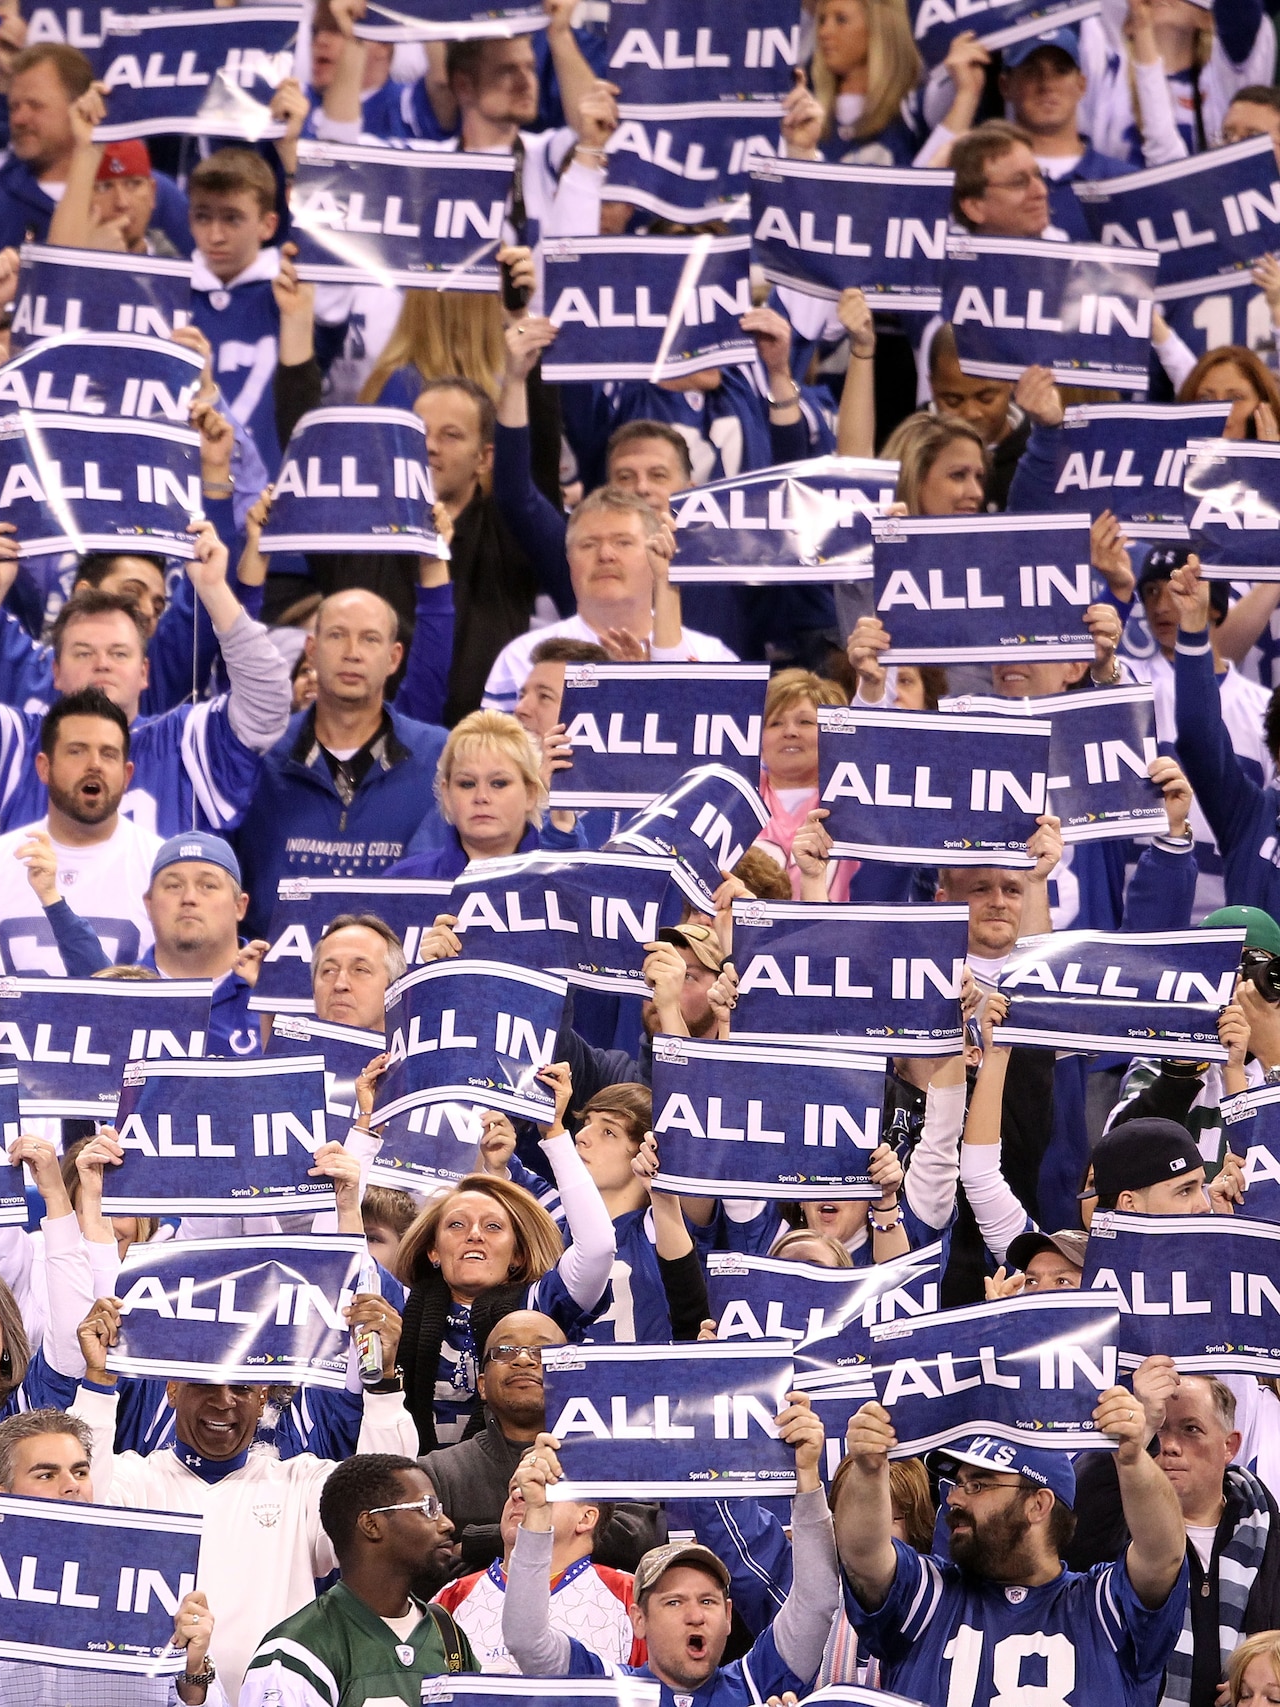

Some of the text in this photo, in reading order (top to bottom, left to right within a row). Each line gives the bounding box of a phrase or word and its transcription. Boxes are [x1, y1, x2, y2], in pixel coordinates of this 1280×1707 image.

[103, 53, 211, 88] ALL
[610, 29, 799, 69] ALL IN
[603, 120, 784, 180] ALL IN
[307, 191, 505, 238] ALL IN
[755, 207, 947, 257] ALL IN
[1100, 182, 1280, 253] ALL IN
[4, 295, 190, 339] ALL IN
[549, 278, 750, 330] ALL IN
[953, 286, 1151, 339] ALL IN
[121, 379, 196, 416] IN
[137, 466, 201, 510] IN
[271, 456, 438, 498] ALL IN
[1055, 450, 1143, 493] ALL
[677, 491, 795, 529] ALL
[877, 565, 1090, 611] ALL IN
[565, 713, 761, 755] ALL IN
[1084, 743, 1157, 784] IN
[821, 762, 1045, 814] ALL IN
[285, 838, 402, 857] INDIANAPOLIS COLTS
[690, 802, 745, 869] IN
[944, 841, 962, 849] Sprint
[456, 891, 659, 937] ALL IN
[738, 956, 963, 999] ALL IN
[1002, 963, 1236, 1000] ALL IN
[129, 1030, 204, 1059] IN
[388, 1009, 557, 1068] ALL IN
[866, 1027, 885, 1036] Sprint
[1128, 1028, 1147, 1037] Sprint
[468, 1077, 487, 1086] Sprint
[116, 1114, 326, 1157] ALL IN
[408, 1107, 481, 1144] IN
[654, 1093, 880, 1145] ALL IN
[231, 1189, 251, 1198] Sprint
[307, 1182, 333, 1190] TOYOTA
[778, 1174, 797, 1182] Sprint
[123, 1277, 258, 1326] ALL
[276, 1285, 353, 1331] IN
[1089, 1272, 1280, 1316] ALL IN
[247, 1356, 265, 1364] Sprint
[547, 1363, 583, 1371] PLAYOFFS
[1205, 1344, 1224, 1353] Sprint
[883, 1346, 1119, 1406] ALL IN
[553, 1395, 789, 1439] ALL IN
[690, 1471, 709, 1480] Sprint
[1021, 1465, 1048, 1485] Reebok
[117, 1567, 193, 1611] IN
[87, 1642, 106, 1651] Sprint
[942, 1624, 1076, 1707] 18
